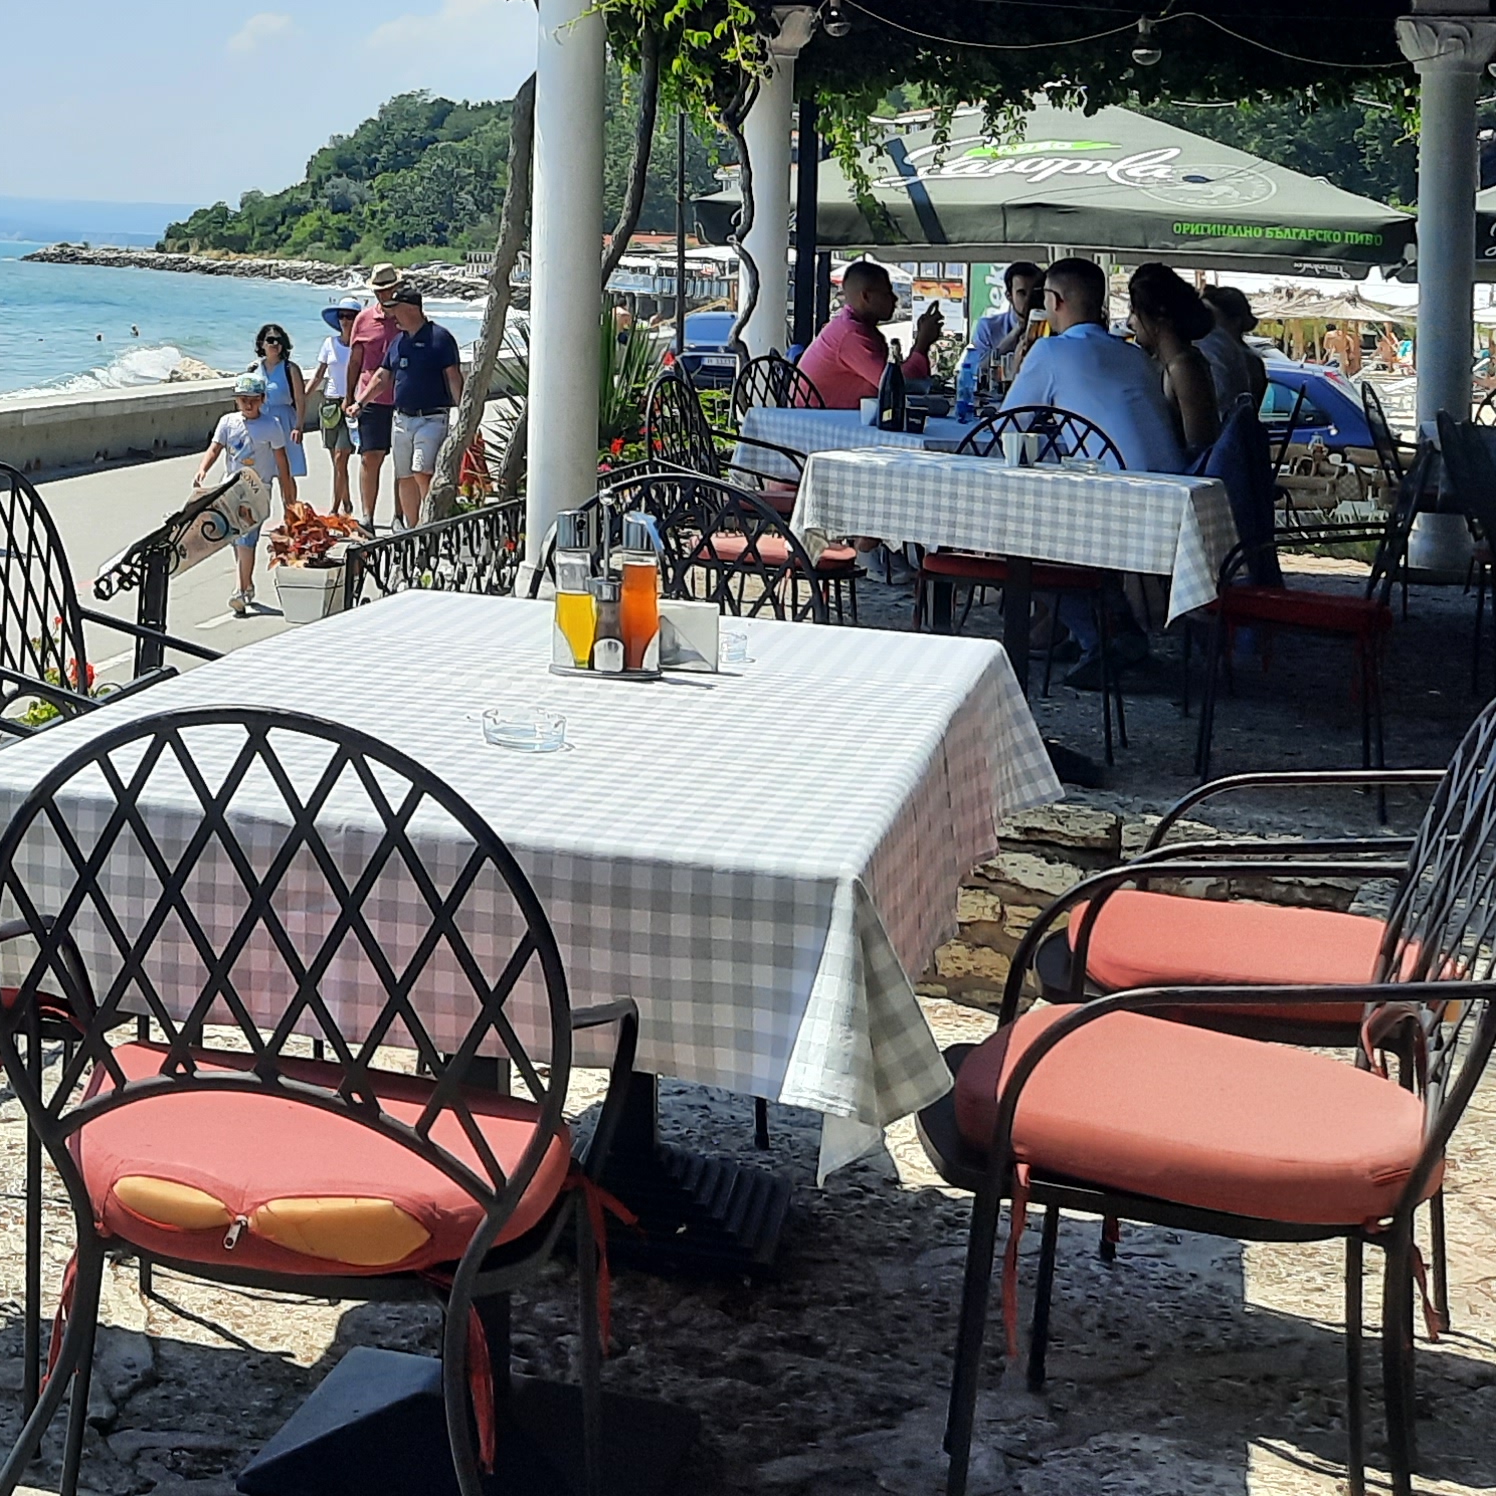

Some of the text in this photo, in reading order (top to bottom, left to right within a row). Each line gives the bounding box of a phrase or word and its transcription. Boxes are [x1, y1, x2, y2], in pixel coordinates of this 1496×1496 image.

[1172, 222, 1383, 246] ОРИГИНАЛНО БЪЛГАРСКО ПИВО
